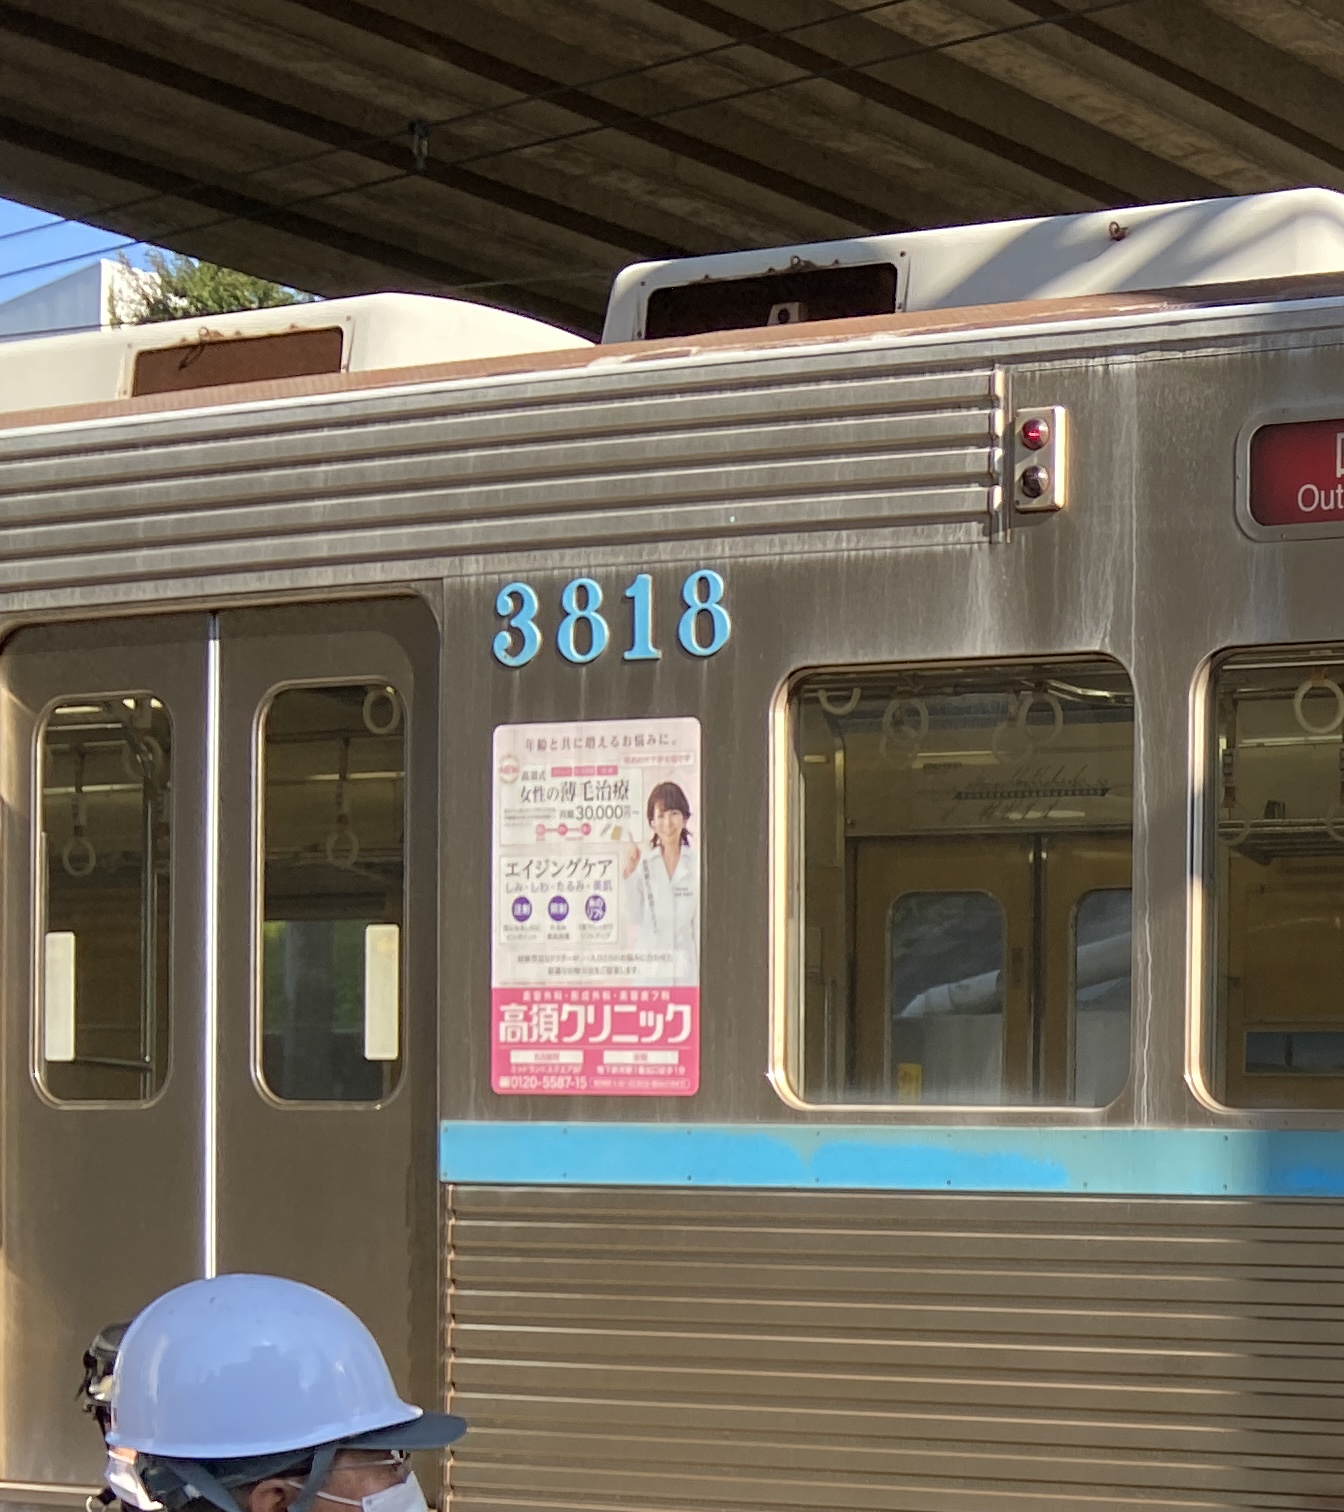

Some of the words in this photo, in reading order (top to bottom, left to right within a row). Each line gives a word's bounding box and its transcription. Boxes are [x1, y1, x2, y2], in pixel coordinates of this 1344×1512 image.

[1297, 483, 1344, 512] Out
[492, 568, 732, 668] 3818
[504, 857, 614, 880] エイジングケア
[498, 1002, 693, 1044] 高須クリニック
